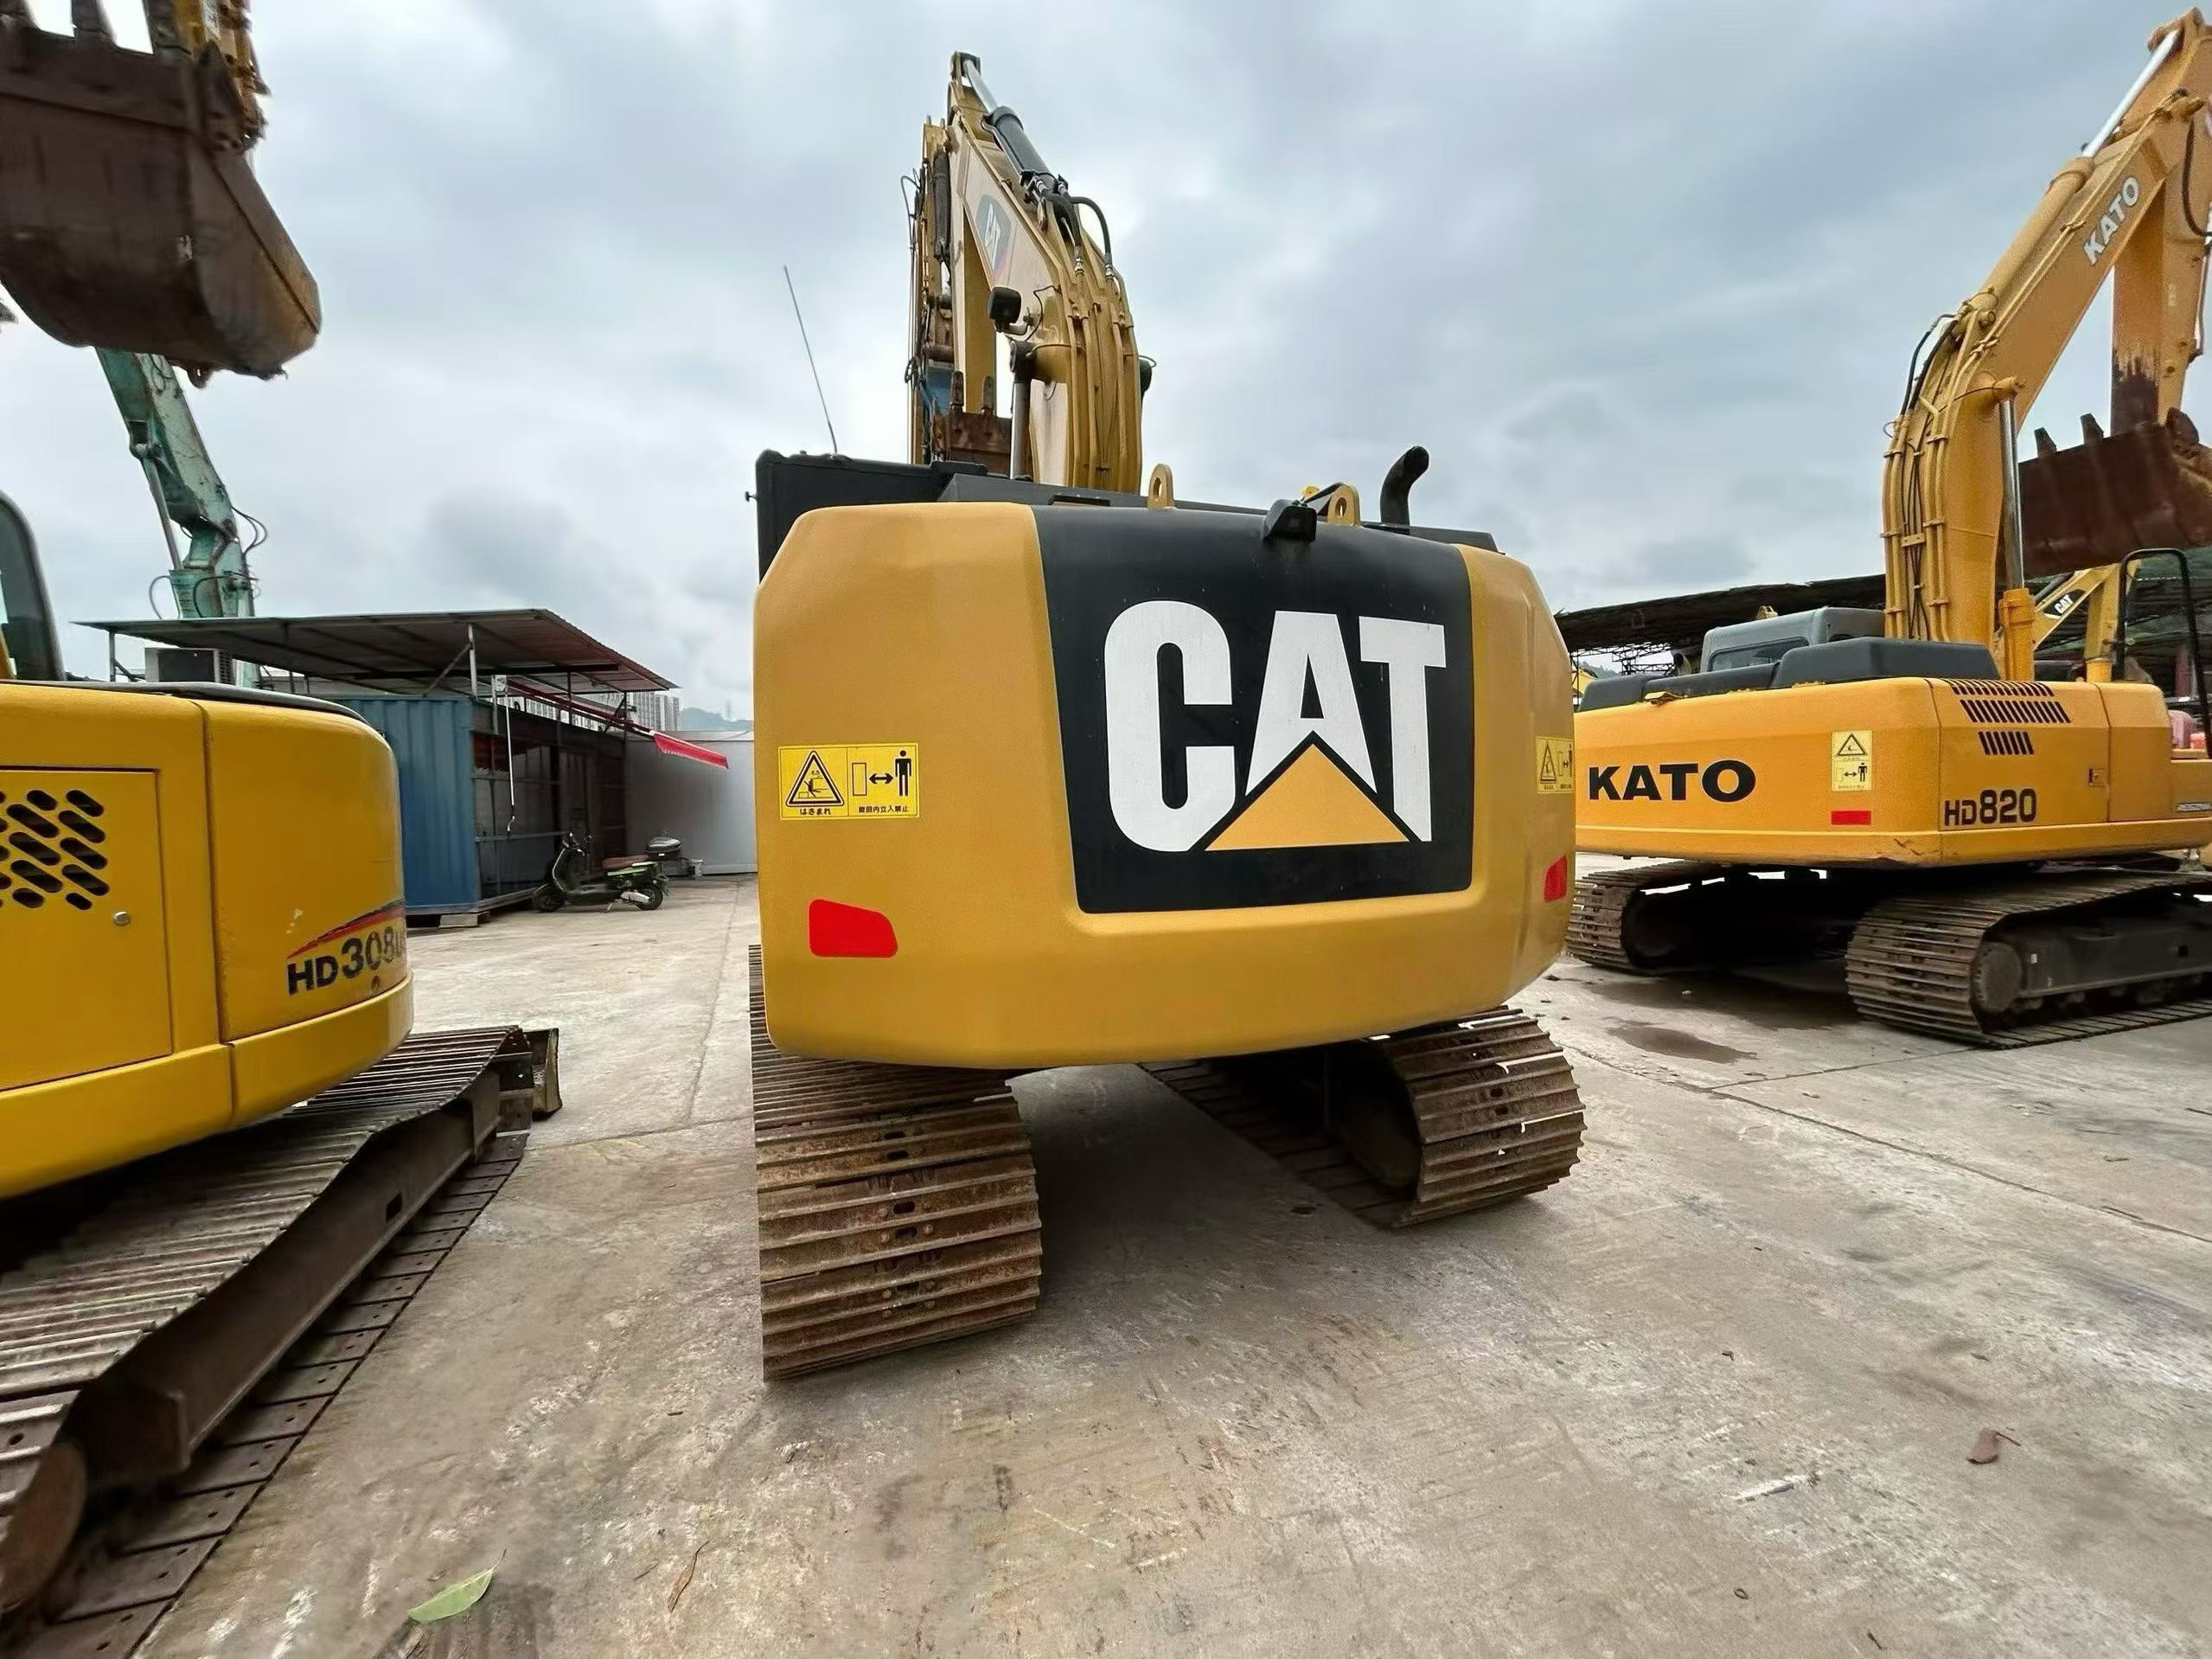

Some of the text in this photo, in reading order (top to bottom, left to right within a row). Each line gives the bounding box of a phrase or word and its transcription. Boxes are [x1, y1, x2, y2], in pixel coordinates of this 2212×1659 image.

[2083, 176, 2139, 266] KATO
[2054, 594, 2074, 614] CAT
[1104, 600, 1446, 852] CAT
[1589, 759, 1756, 803] KATO
[799, 807, 831, 816] はさまれ
[1944, 788, 2036, 826] HD820
